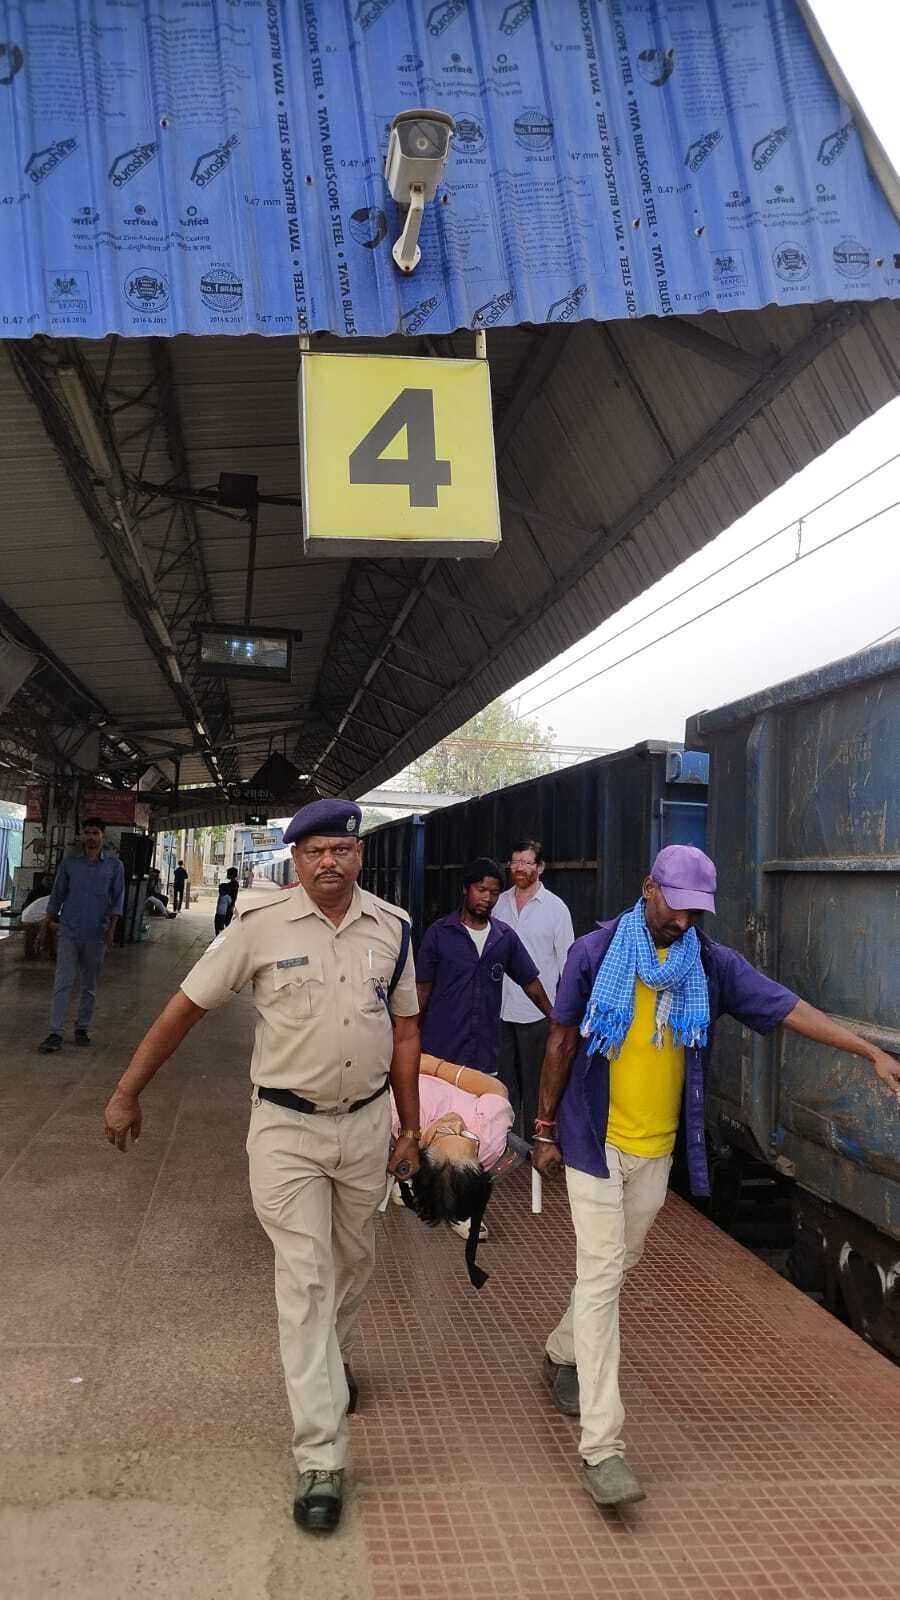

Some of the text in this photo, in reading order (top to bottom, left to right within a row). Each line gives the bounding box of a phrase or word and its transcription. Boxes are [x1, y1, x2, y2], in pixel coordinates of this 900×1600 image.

[273, 63, 285, 95] TATA
[312, 58, 325, 90] STEEL
[589, 63, 601, 95] TATA
[620, 56, 634, 87] STEEL
[278, 112, 290, 144] STEEL
[317, 107, 331, 142] TATA
[596, 112, 609, 141] STEEL
[628, 100, 641, 132] TATA
[280, 147, 297, 214] BLUESCOPE
[322, 145, 340, 211] BLUESCOPE
[602, 145, 620, 206] BLUESCOPE
[633, 134, 652, 196] BLUESCOPE
[612, 210, 624, 241] TATA
[644, 198, 658, 228] STEEL
[288, 218, 301, 252] TATA
[331, 214, 344, 248] STEEL
[620, 256, 632, 287] STEEL
[652, 244, 667, 278] TATA
[293, 271, 306, 303] STEEL
[338, 262, 351, 297] TATA
[275, 315, 293, 323] mm
[349, 388, 452, 507] 4
